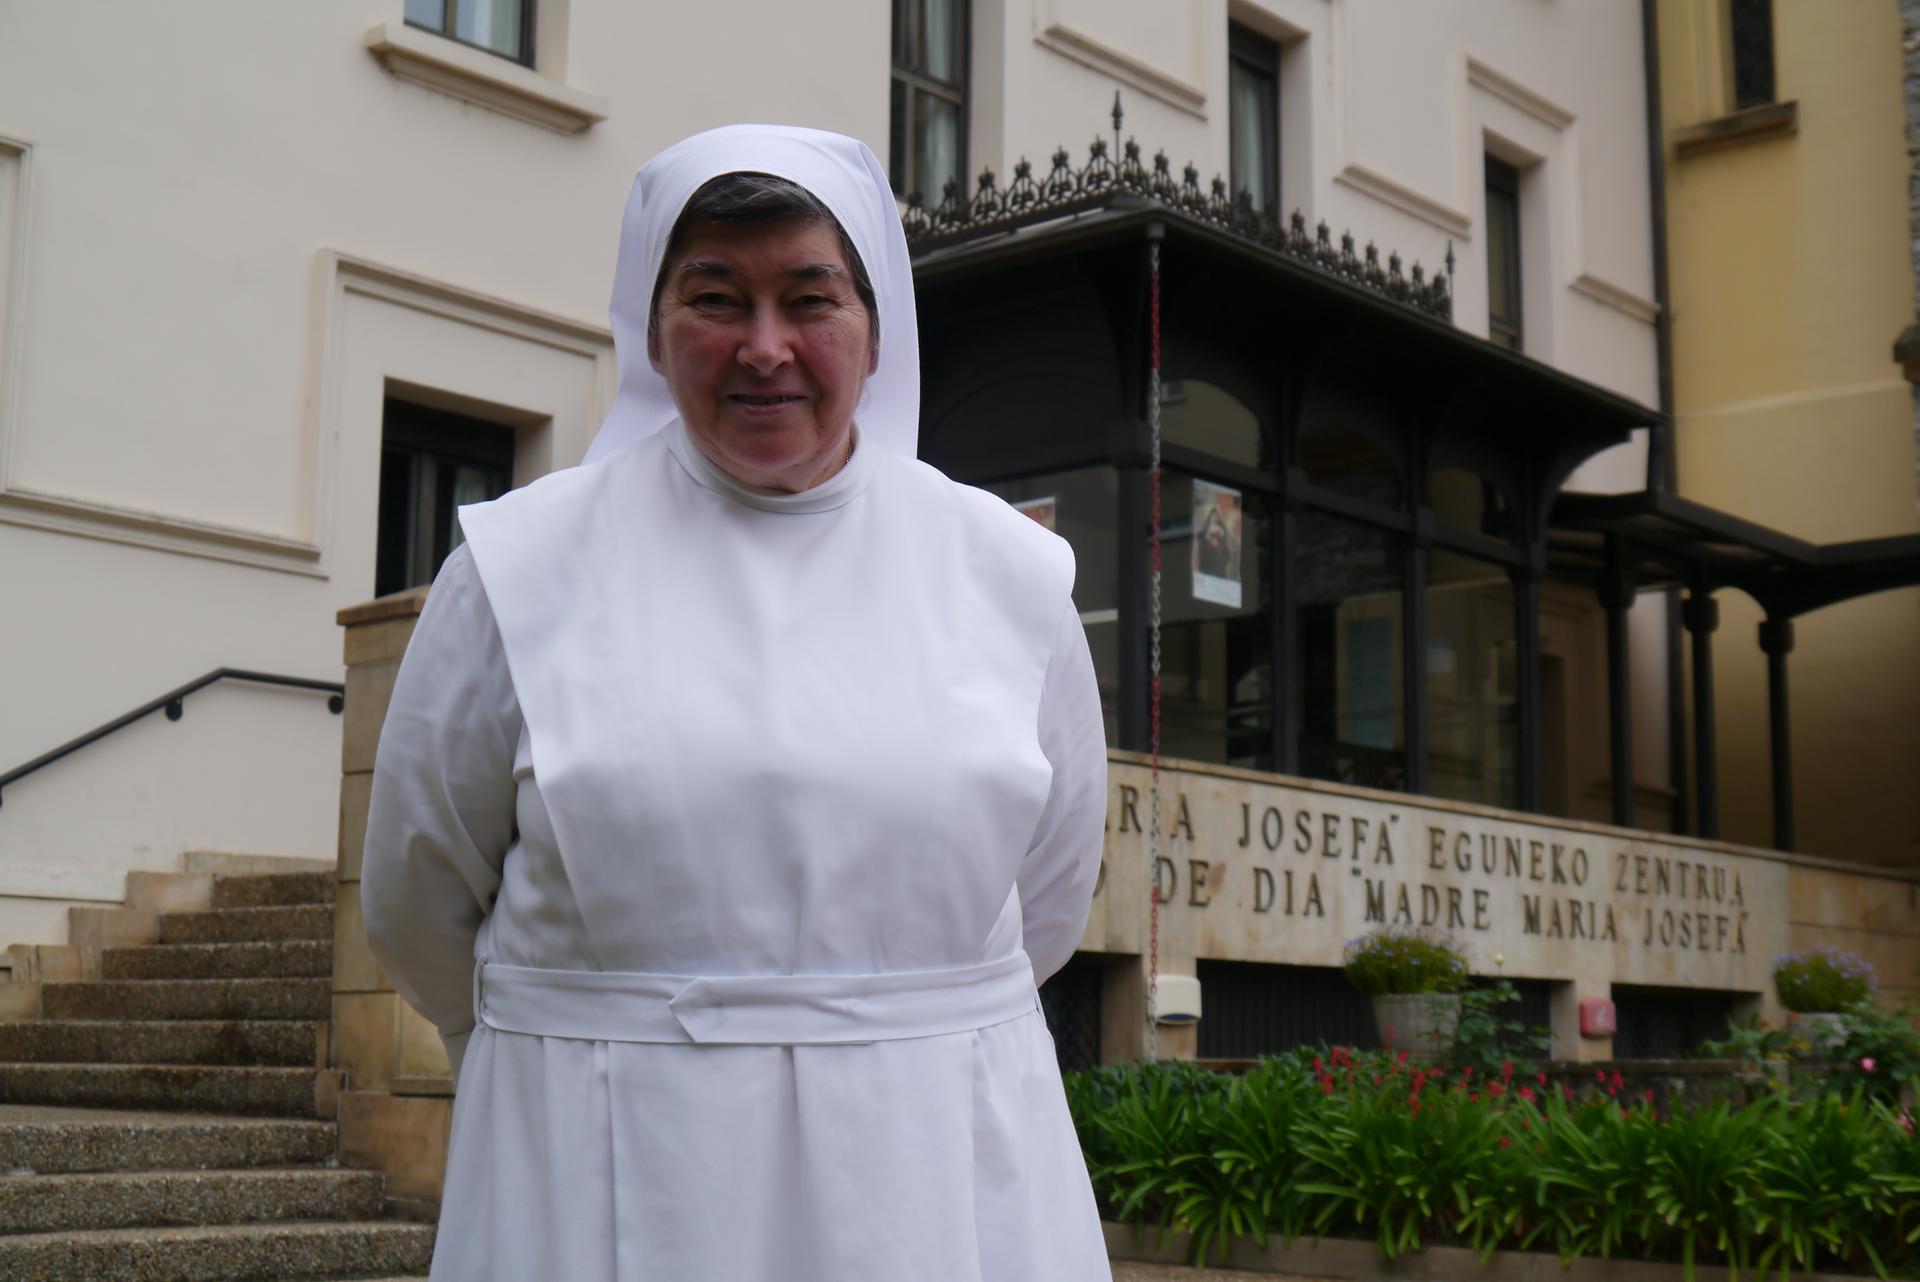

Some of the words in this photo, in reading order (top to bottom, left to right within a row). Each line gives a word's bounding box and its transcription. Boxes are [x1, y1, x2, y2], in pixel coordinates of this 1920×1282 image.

[1155, 855, 1211, 908] DE
[1253, 866, 1325, 917] DIA
[1523, 893, 1617, 942] MARIA
[1428, 826, 1589, 887] EGUNEKO
[1615, 853, 1744, 906] ZENTRUA
